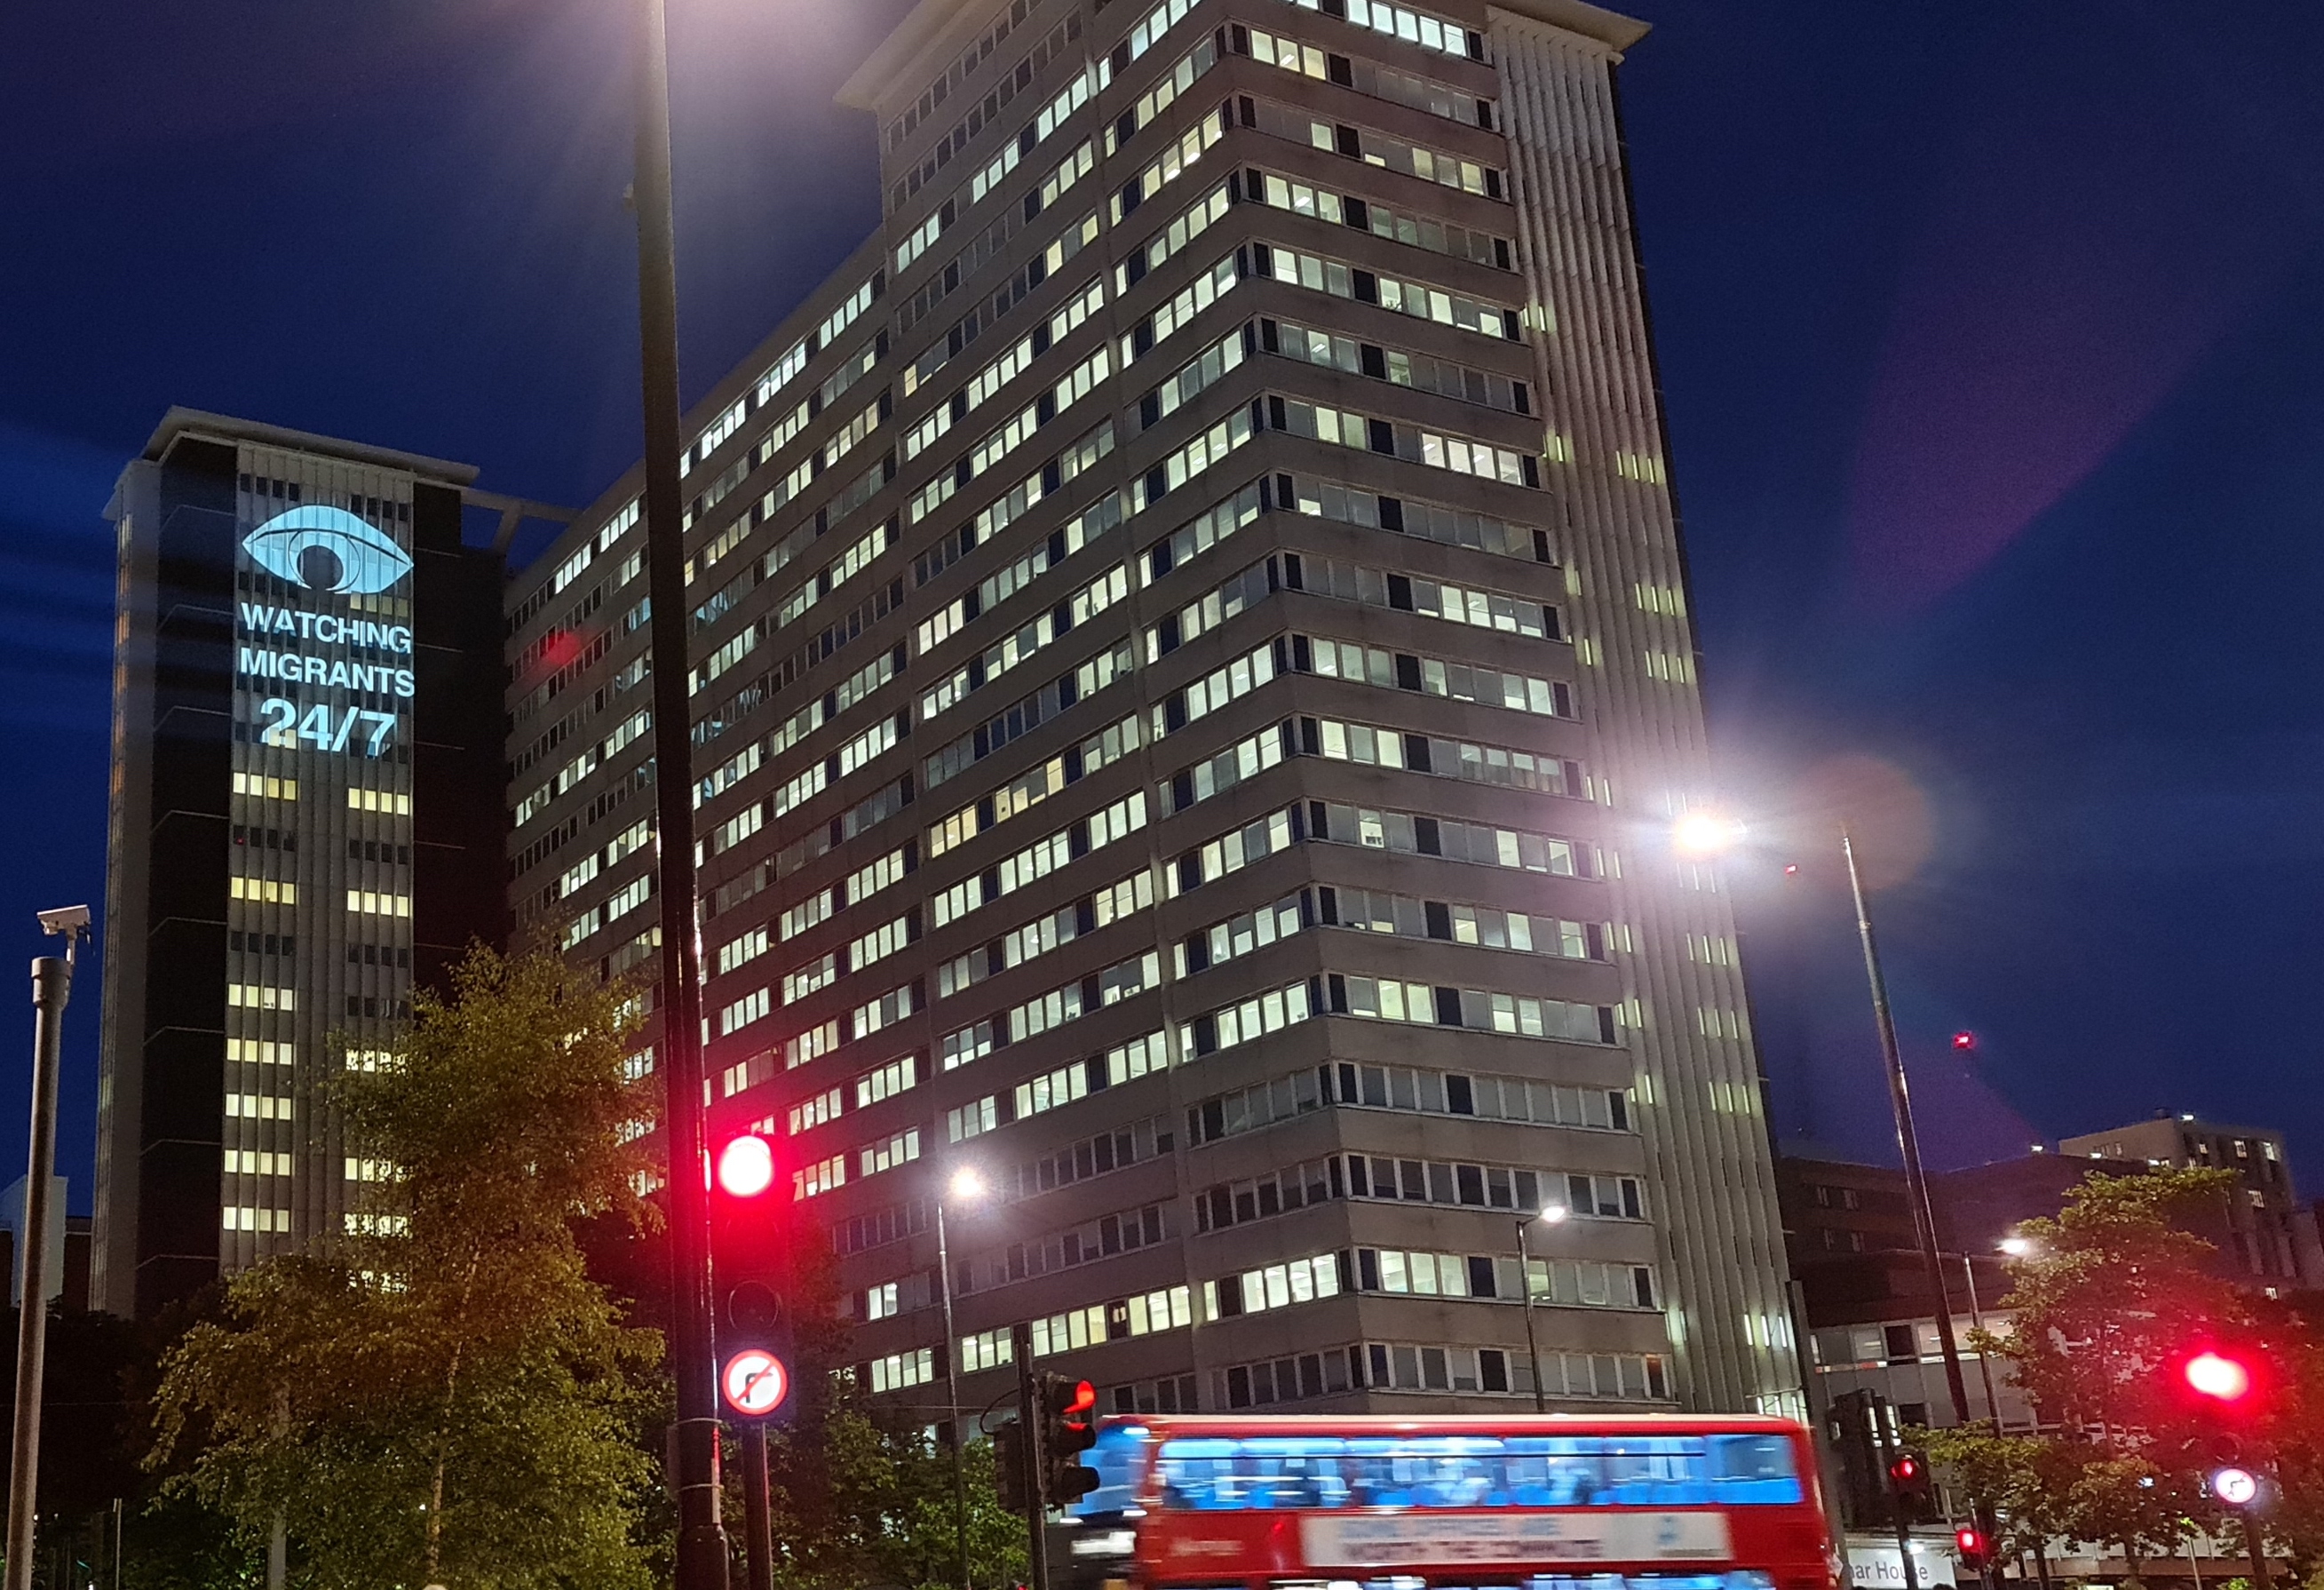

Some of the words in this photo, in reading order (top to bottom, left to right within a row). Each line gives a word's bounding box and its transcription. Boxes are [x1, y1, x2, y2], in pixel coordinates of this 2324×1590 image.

[241, 602, 411, 654] WATCHING
[241, 647, 415, 697] MIGRANTS
[260, 697, 396, 759] 24/7
[1875, 1561, 1929, 1580] Houe
